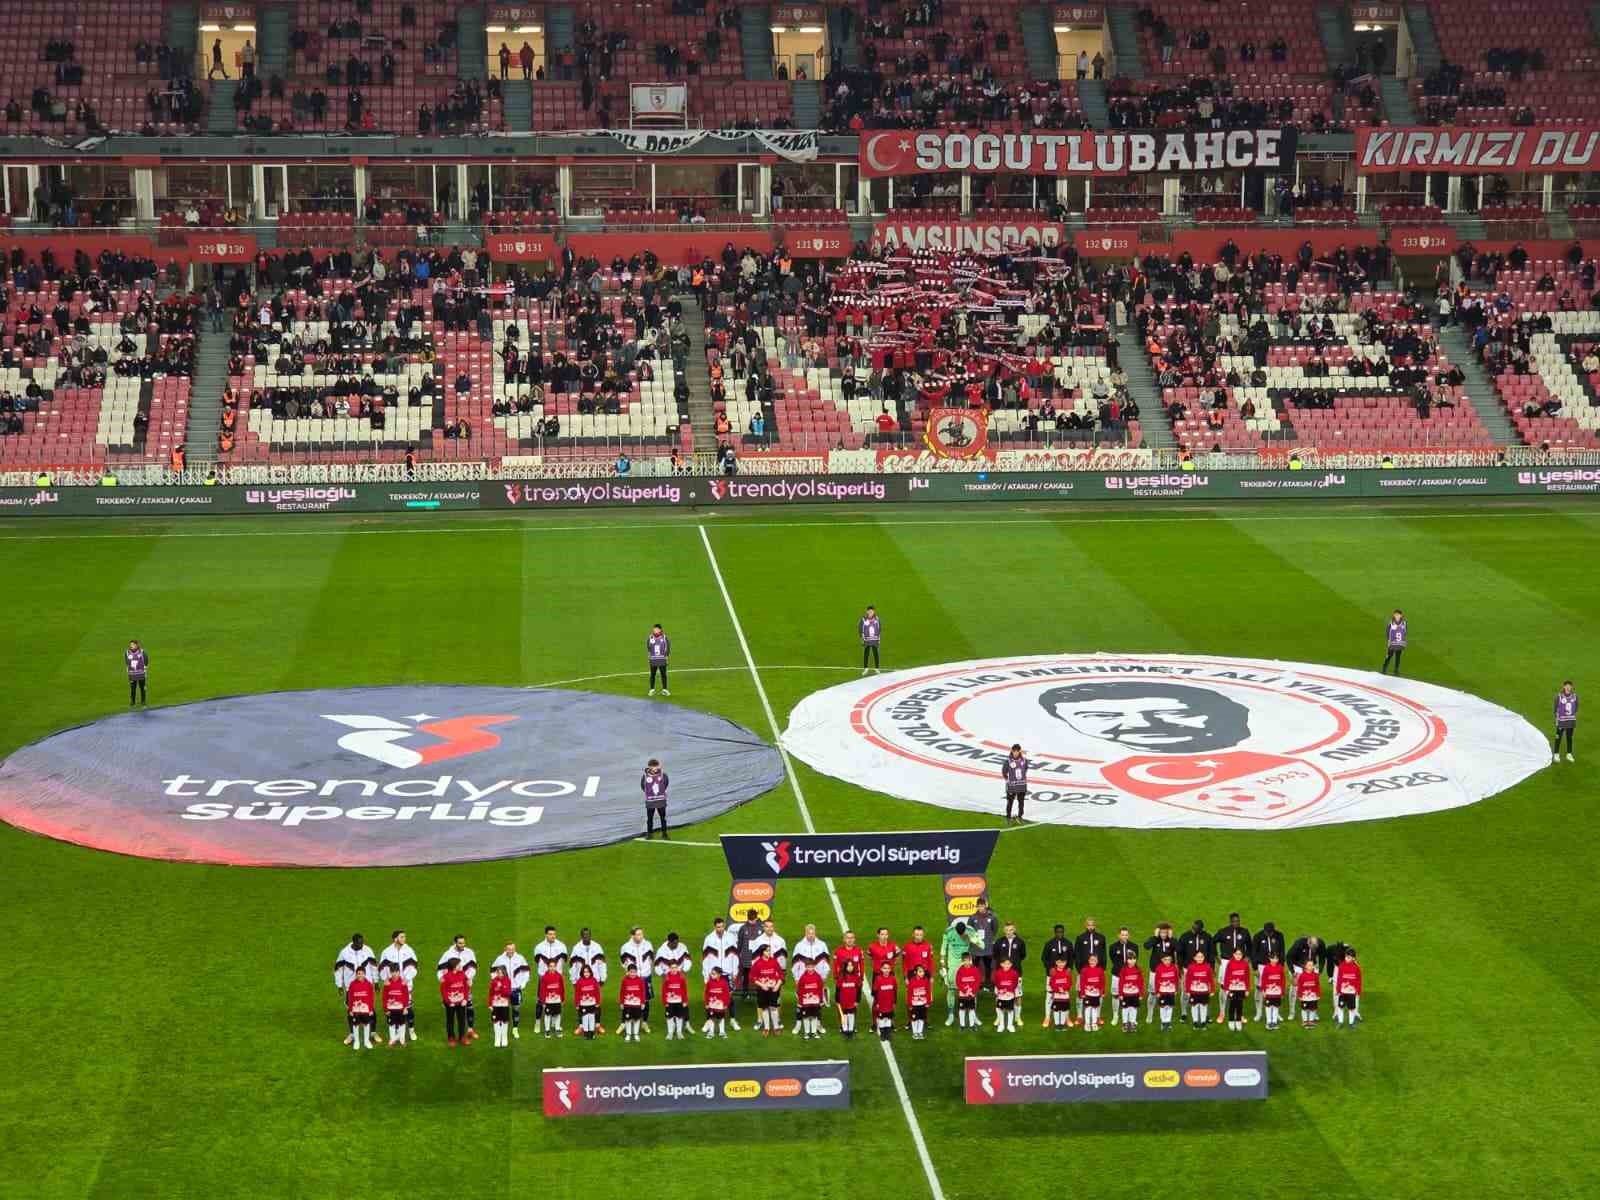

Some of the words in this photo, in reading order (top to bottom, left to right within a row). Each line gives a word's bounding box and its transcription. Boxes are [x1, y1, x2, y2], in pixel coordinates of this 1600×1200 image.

[1360, 131, 1526, 166] KIRMIZI
[497, 242, 515, 253] 130
[526, 242, 543, 253] 131
[1084, 239, 1101, 249] 132
[1113, 239, 1129, 249] 133
[267, 486, 357, 502] yeşiloğlu
[523, 483, 610, 504] trendyol
[728, 479, 815, 500] trendyol
[276, 502, 331, 511] RESTAURANT
[1012, 665, 1204, 679] MEHMET
[1285, 680, 1393, 717] YILMAZ
[1319, 717, 1401, 761] SEZONU
[161, 774, 601, 802] trendyol
[1346, 771, 1449, 795] 2026
[793, 844, 886, 867] trendyol
[1006, 1070, 1077, 1089] trendyol
[584, 1081, 657, 1100] trendyol
